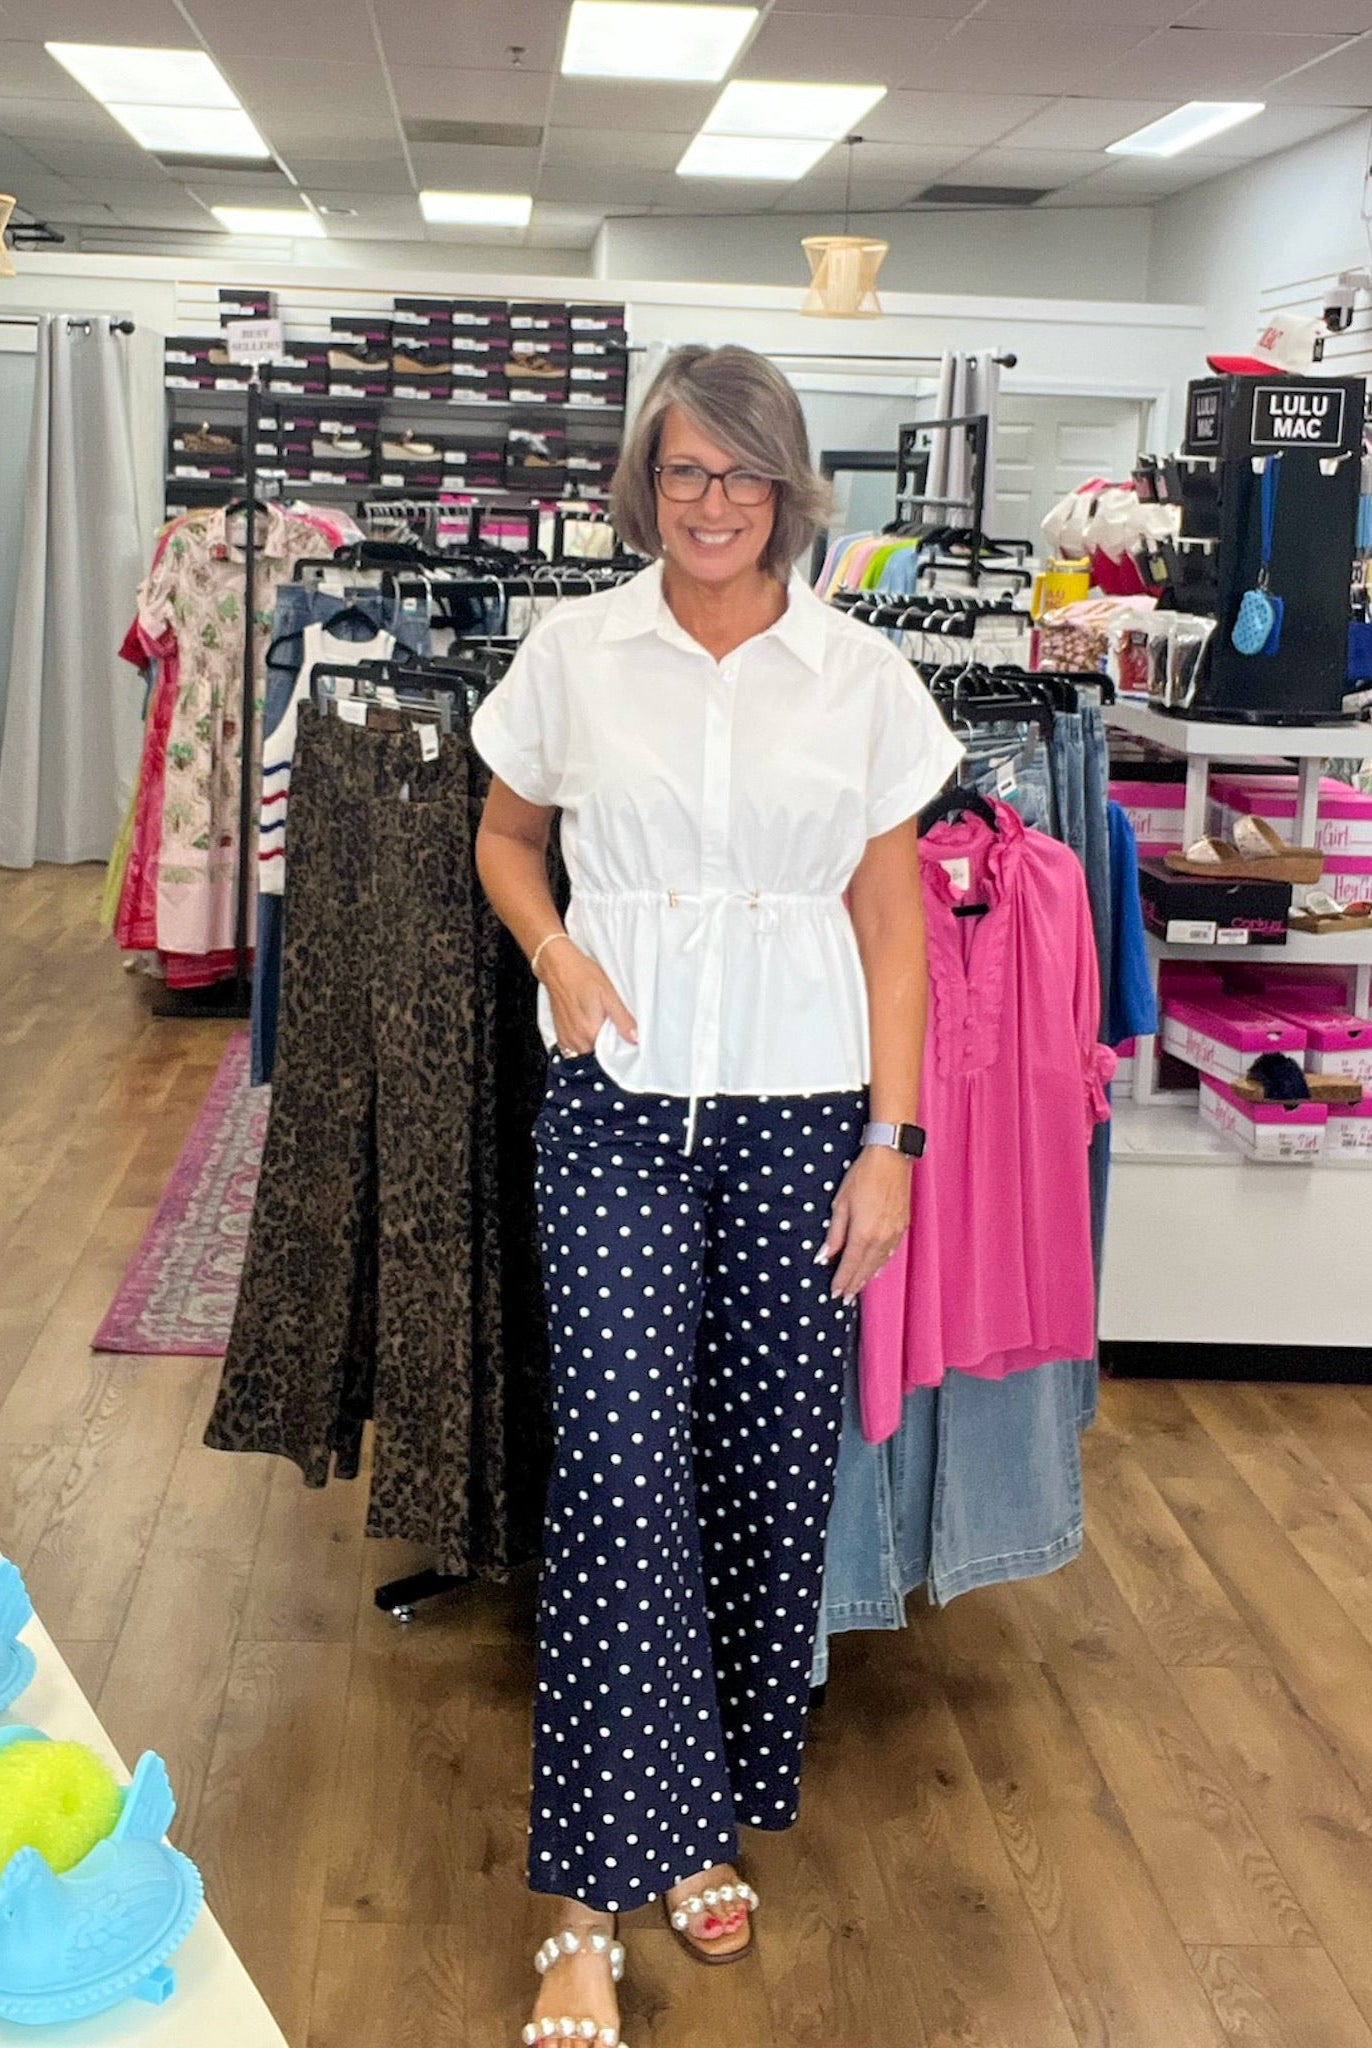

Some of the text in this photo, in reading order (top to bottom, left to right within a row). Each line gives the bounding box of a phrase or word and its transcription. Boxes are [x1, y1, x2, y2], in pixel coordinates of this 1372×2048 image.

[241, 329, 269, 339] BEST
[1195, 394, 1218, 416] LULU
[1268, 393, 1329, 417] LULU
[1196, 417, 1215, 438] MAC
[1272, 417, 1323, 440] MAC
[1126, 807, 1152, 834] Girl
[1313, 820, 1349, 850] yGirl
